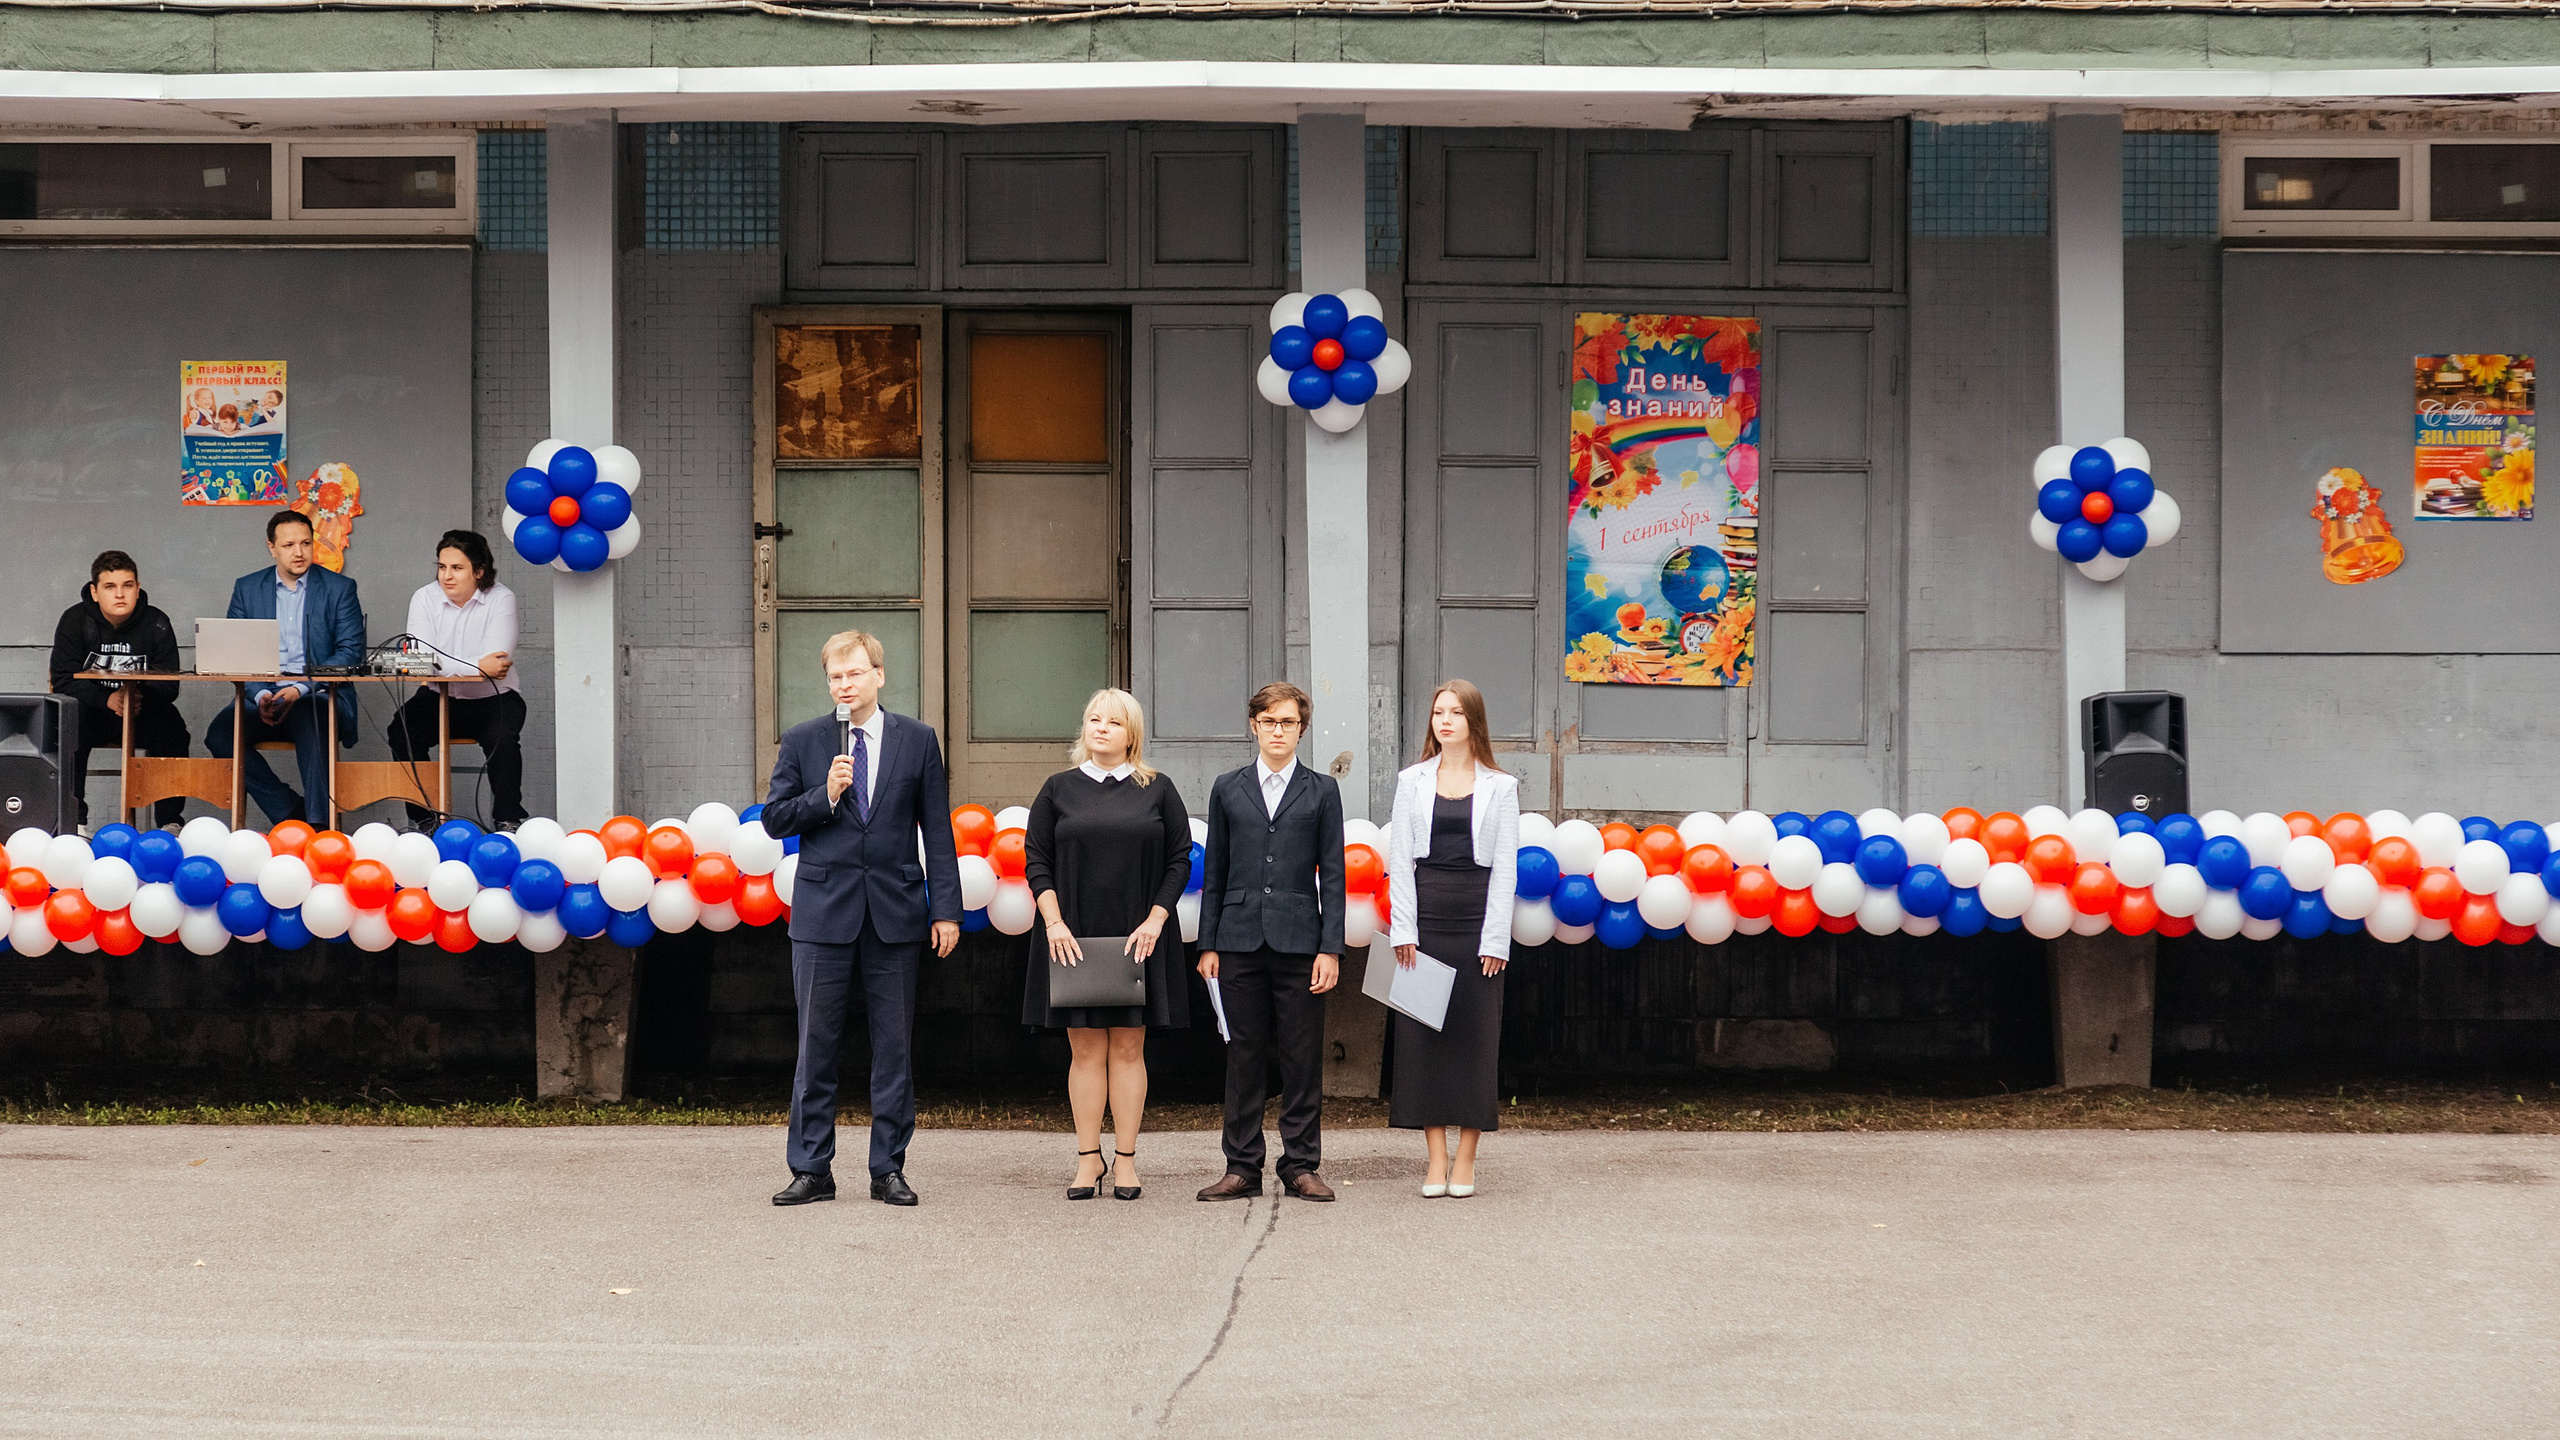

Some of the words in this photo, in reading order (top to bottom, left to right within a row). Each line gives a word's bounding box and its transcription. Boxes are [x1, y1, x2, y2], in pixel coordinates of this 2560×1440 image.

[198, 363, 244, 374] ПЕРВЫЙ
[247, 365, 267, 374] РАЗ
[186, 377, 193, 385] В
[196, 375, 241, 385] ПЕРВЫЙ
[244, 377, 282, 385] КЛАСС!
[1626, 367, 1707, 393] День
[1608, 397, 1724, 418] знаний
[2420, 398, 2445, 427] С
[2445, 400, 2505, 426] Днём
[2418, 427, 2502, 445] ЗНАНИЙ!
[1599, 526, 1607, 551] 1
[1623, 502, 1712, 544] сентября
